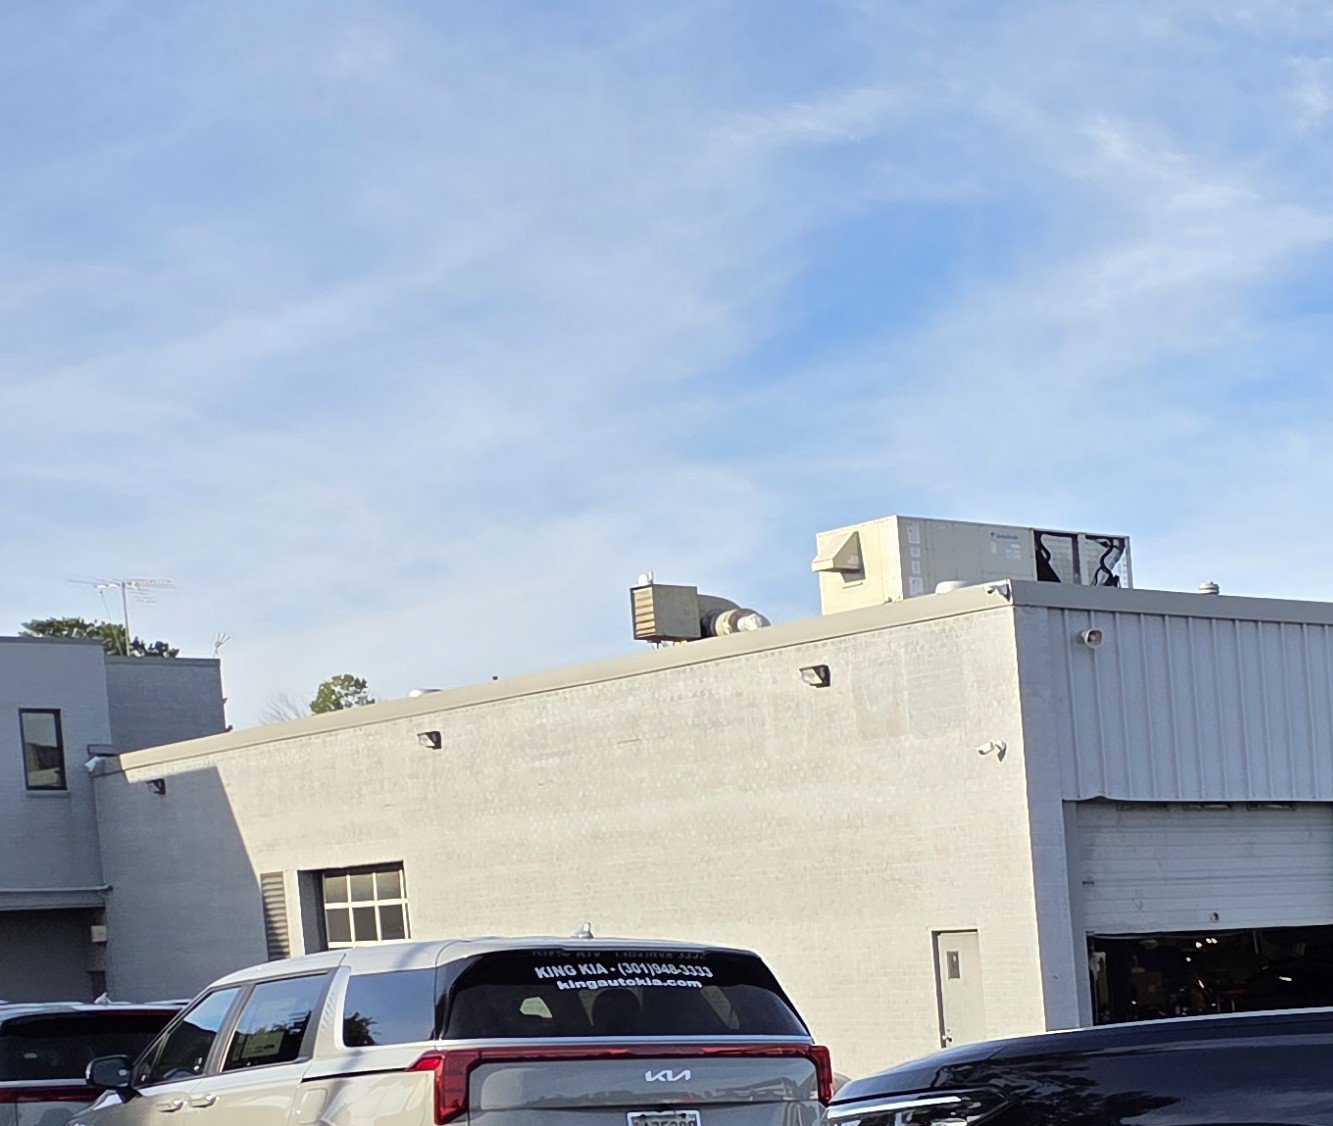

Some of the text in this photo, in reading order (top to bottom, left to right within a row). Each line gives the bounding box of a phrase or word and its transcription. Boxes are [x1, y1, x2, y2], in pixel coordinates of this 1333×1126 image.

[534, 963, 576, 979] KING
[577, 962, 608, 976] KIA
[617, 962, 713, 978] (301)948-3333
[556, 977, 703, 990] kingautokia.com
